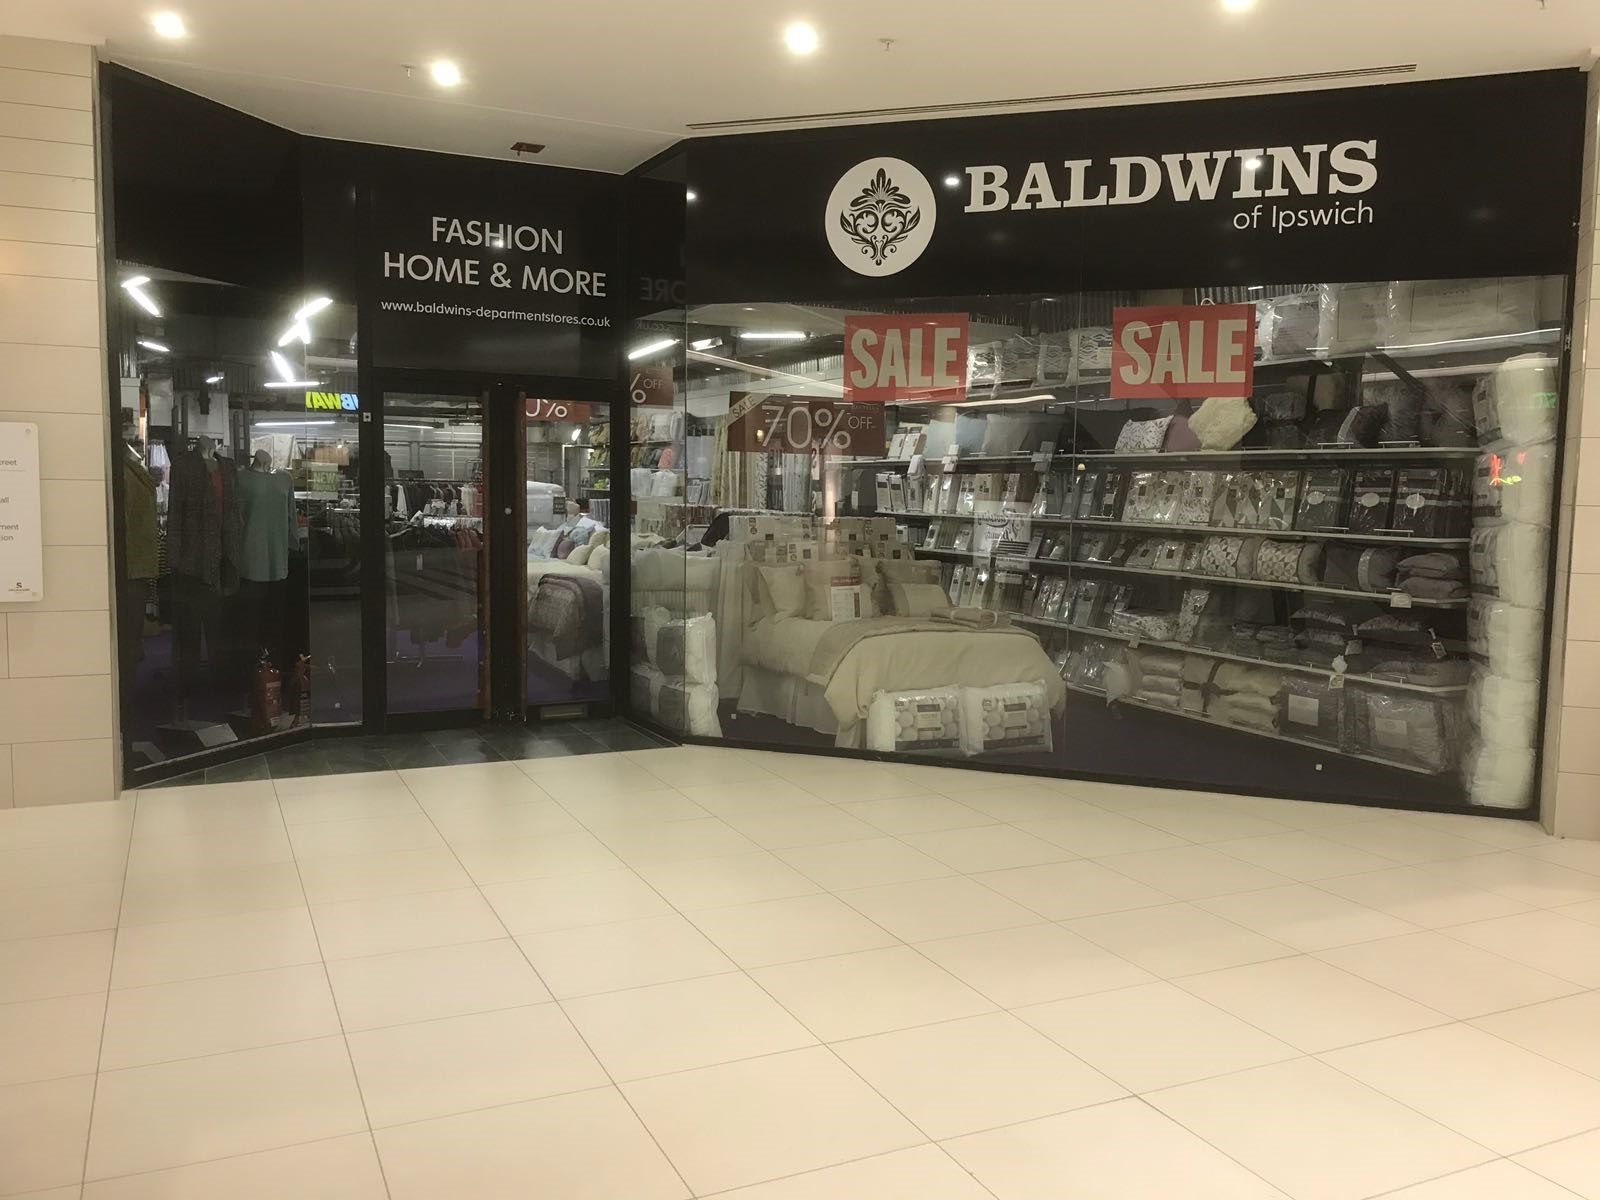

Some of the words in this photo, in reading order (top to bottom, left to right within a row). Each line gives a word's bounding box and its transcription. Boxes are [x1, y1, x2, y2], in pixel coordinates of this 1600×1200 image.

[964, 139, 1378, 213] BALDWINS
[432, 216, 563, 255] FASHION
[1233, 205, 1263, 230] of
[1272, 200, 1373, 233] Ipswich
[384, 251, 480, 286] HOME
[490, 262, 512, 289] &
[521, 265, 607, 297] MORE
[380, 301, 611, 327] www.baldwins-departmentstores.co.uk
[850, 327, 961, 389] SALE
[1119, 319, 1248, 386] SALE
[643, 378, 664, 389] OFF
[731, 395, 757, 418] SALE
[761, 404, 852, 450] 70%
[847, 416, 873, 429] OFF
[313, 472, 336, 484] NEW
